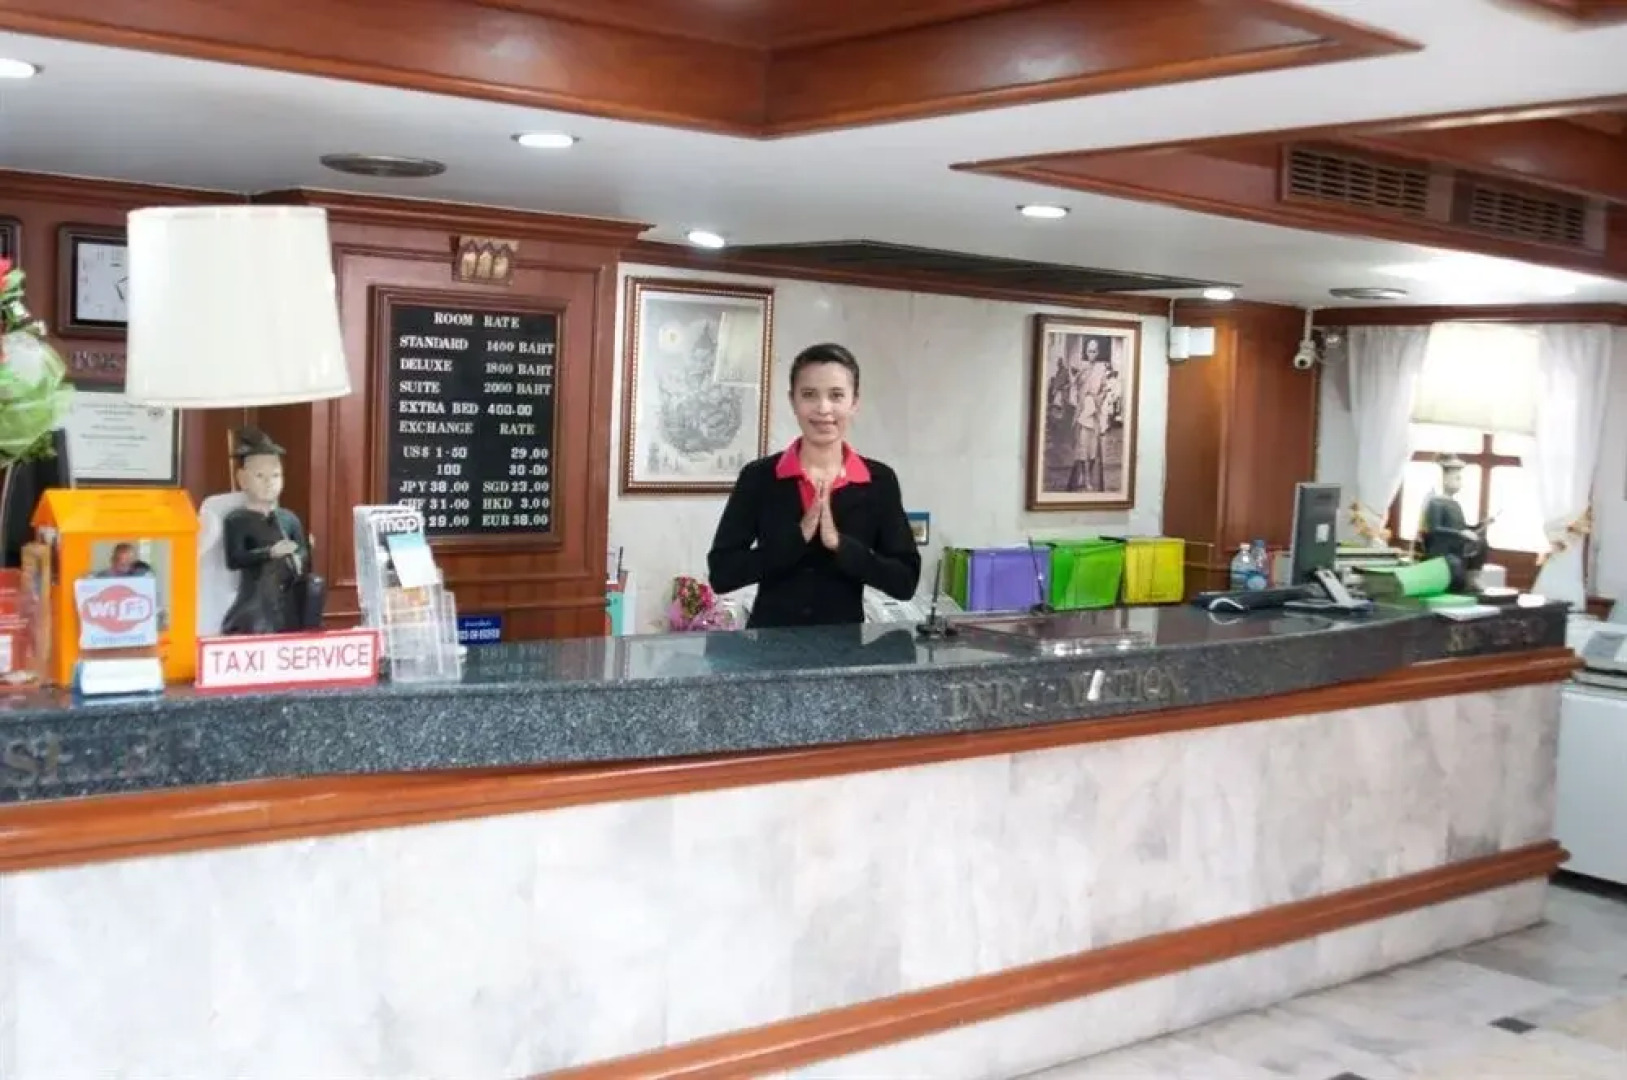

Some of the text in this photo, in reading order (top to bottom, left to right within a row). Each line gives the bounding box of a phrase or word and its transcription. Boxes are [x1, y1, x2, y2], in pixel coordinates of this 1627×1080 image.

[433, 311, 520, 329] ROOM RATE
[399, 334, 555, 355] STANDARD 1400 BAHT
[400, 358, 453, 372] DELUXE
[517, 363, 554, 377] BAHT
[399, 381, 553, 396] SUITE 2000 BAHT
[399, 401, 445, 414] EXTRA
[452, 402, 479, 415] BED
[399, 421, 536, 436] EXCHANGE RATE
[436, 463, 462, 477] 100
[399, 480, 427, 493] JPY
[482, 481, 510, 494] SGD
[482, 498, 513, 510] HKD
[482, 514, 511, 527] EUR
[209, 643, 371, 674] TAXI SERVICE
